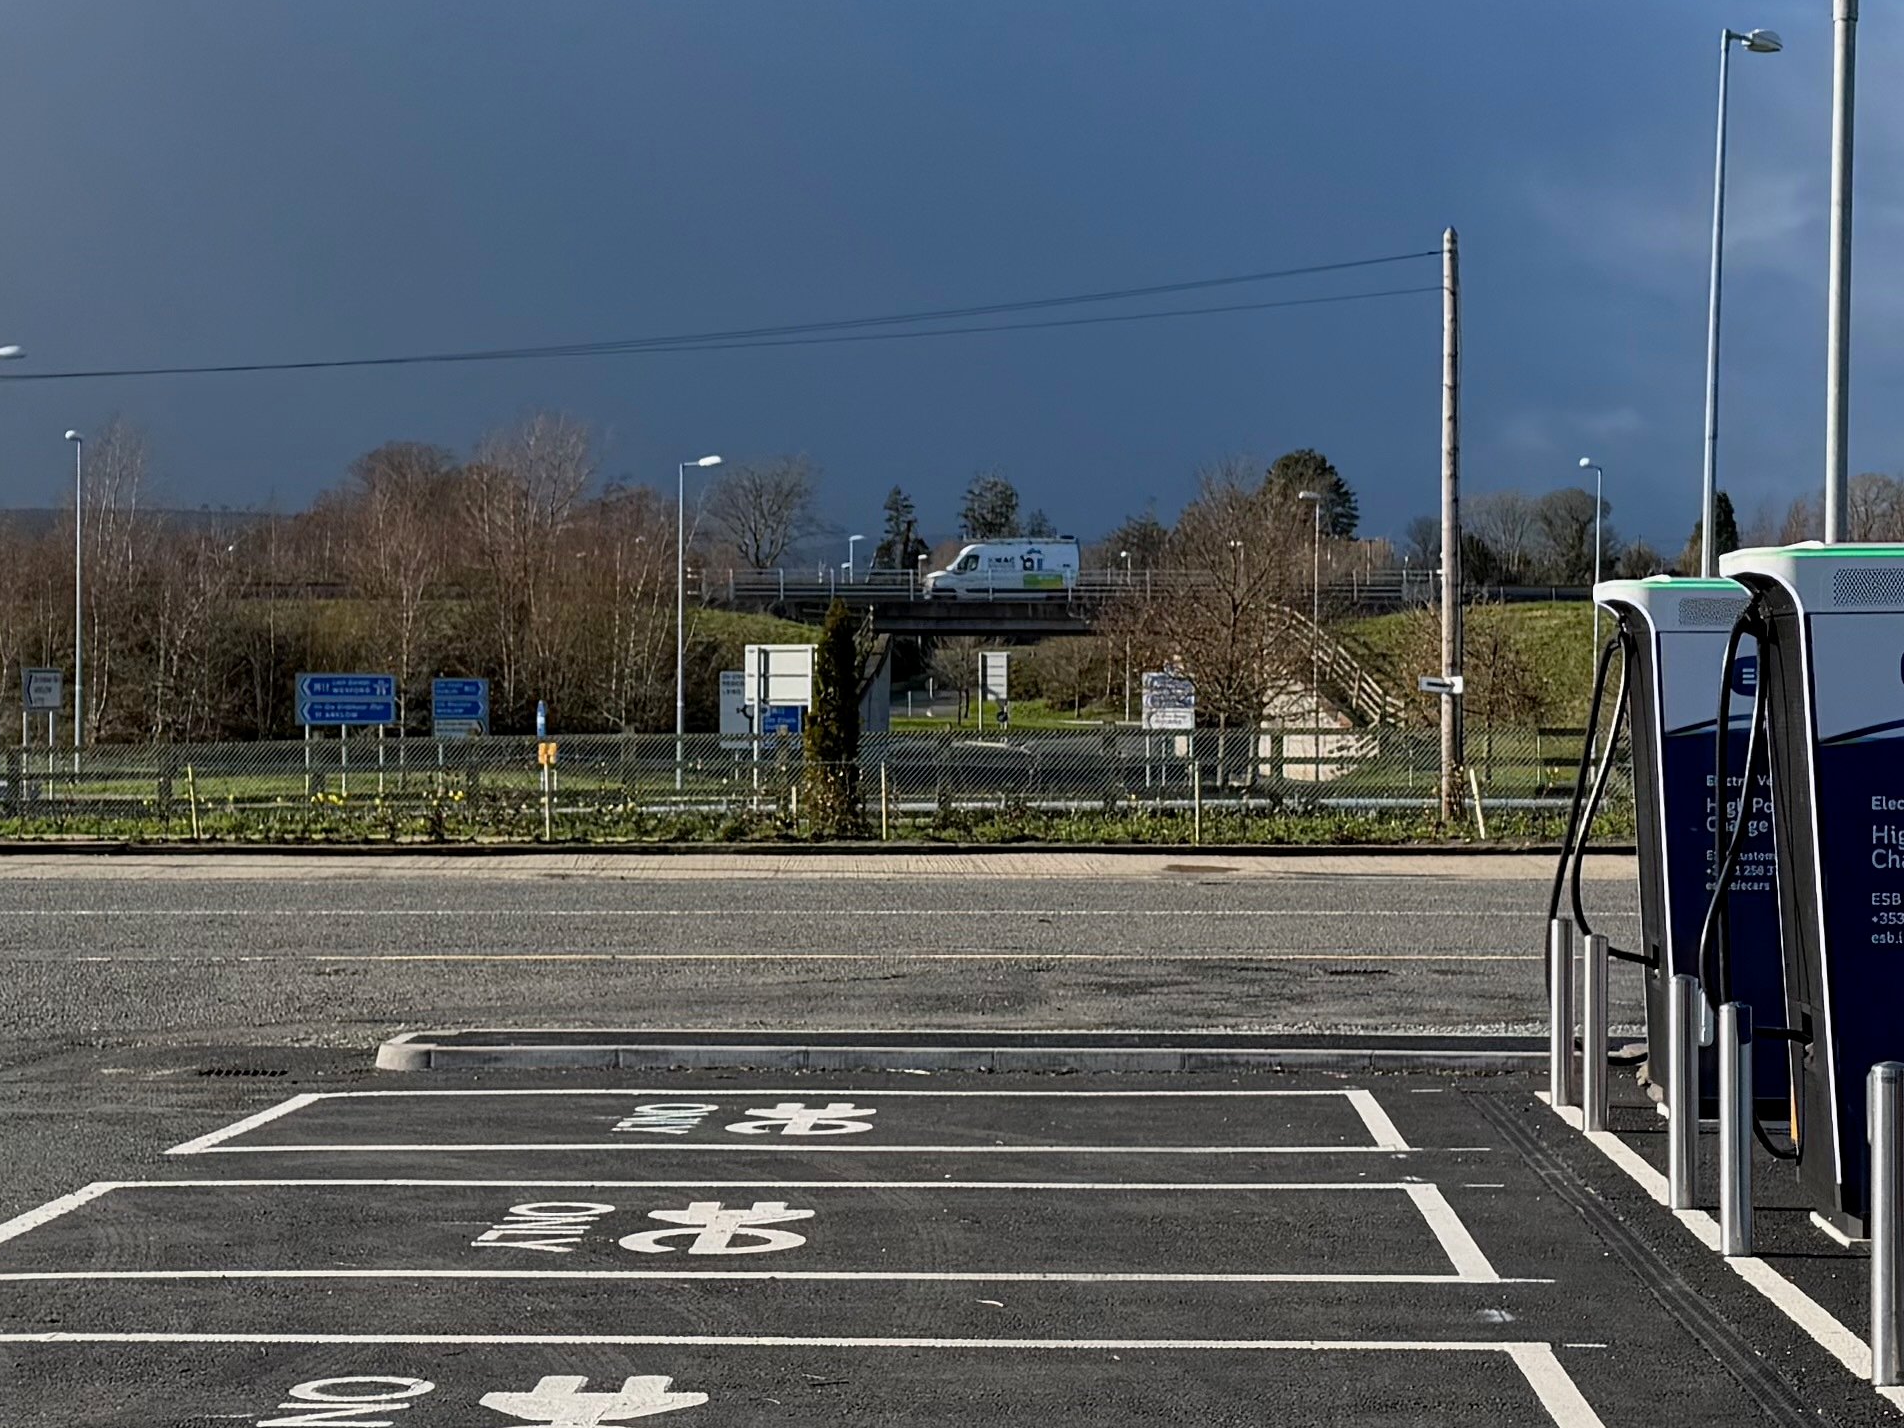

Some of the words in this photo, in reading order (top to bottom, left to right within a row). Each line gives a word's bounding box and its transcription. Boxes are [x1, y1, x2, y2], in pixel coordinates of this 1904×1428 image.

[1871, 892, 1901, 906] ESB
[1871, 912, 1904, 925] +353
[470, 1201, 616, 1253] ONLY
